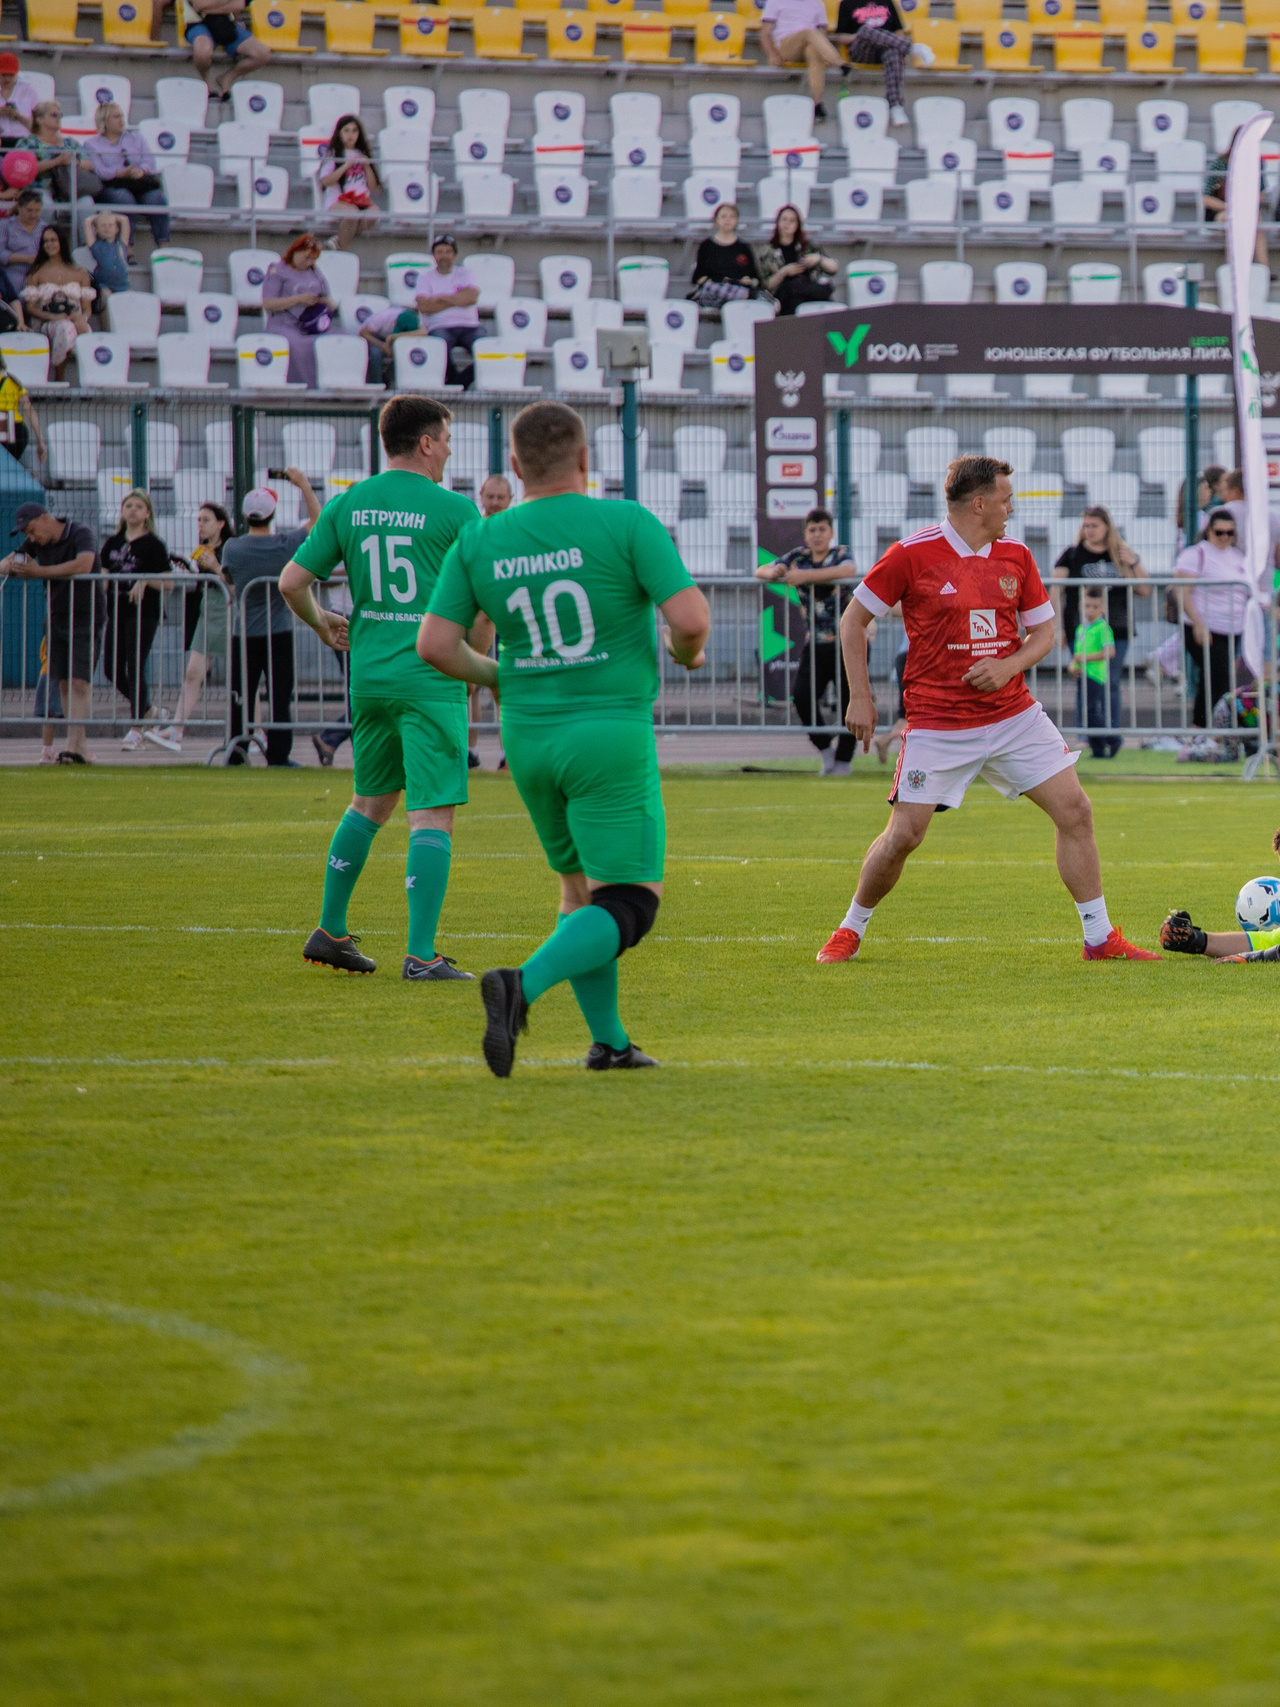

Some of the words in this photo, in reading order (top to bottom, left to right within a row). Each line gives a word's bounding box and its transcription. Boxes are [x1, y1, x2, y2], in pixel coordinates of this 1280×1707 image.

[866, 342, 922, 363] ЮФЛ
[984, 346, 1087, 361] ЮНОШЕСКАЯ
[1088, 346, 1191, 361] ФУТБОЛЬНАЯ
[352, 510, 426, 530] ПЕТРУХИН
[361, 534, 417, 604] 15
[493, 547, 584, 580] КУЛИКОВ
[506, 579, 596, 658] 10
[972, 622, 989, 636] ТМК
